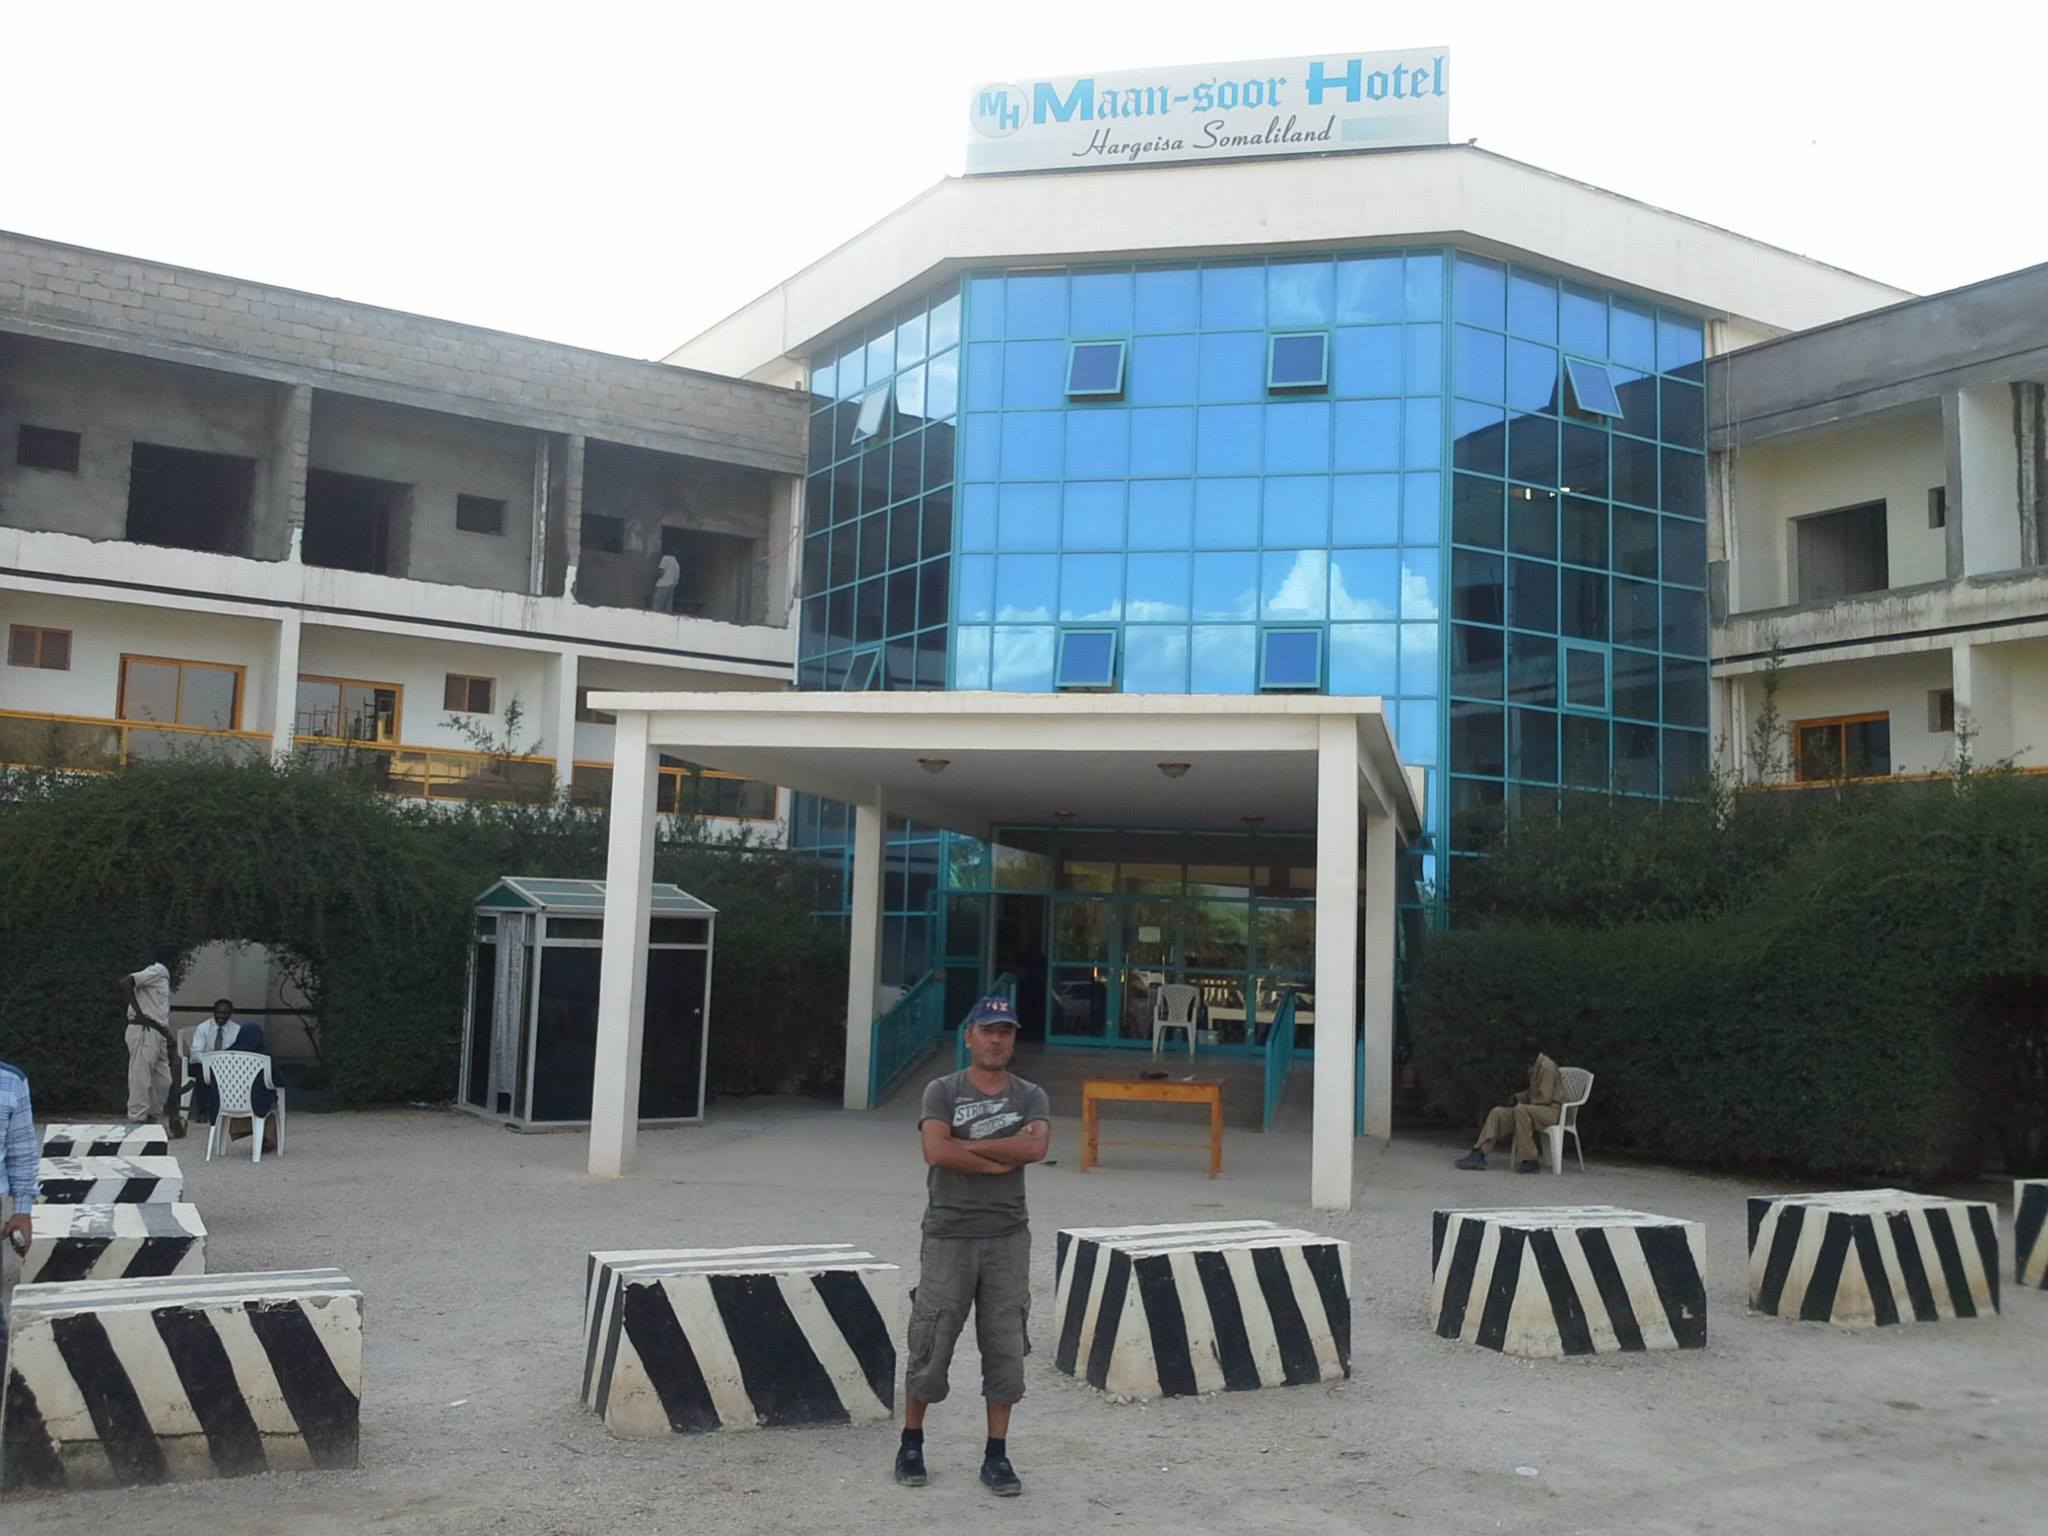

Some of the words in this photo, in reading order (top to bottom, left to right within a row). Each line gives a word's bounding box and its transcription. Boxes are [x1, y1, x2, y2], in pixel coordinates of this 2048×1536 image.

[1033, 78, 1287, 124] Maan-soor
[1305, 56, 1446, 105] Hotel
[1072, 128, 1184, 161] Hargeisa
[1193, 115, 1336, 149] Somaliland
